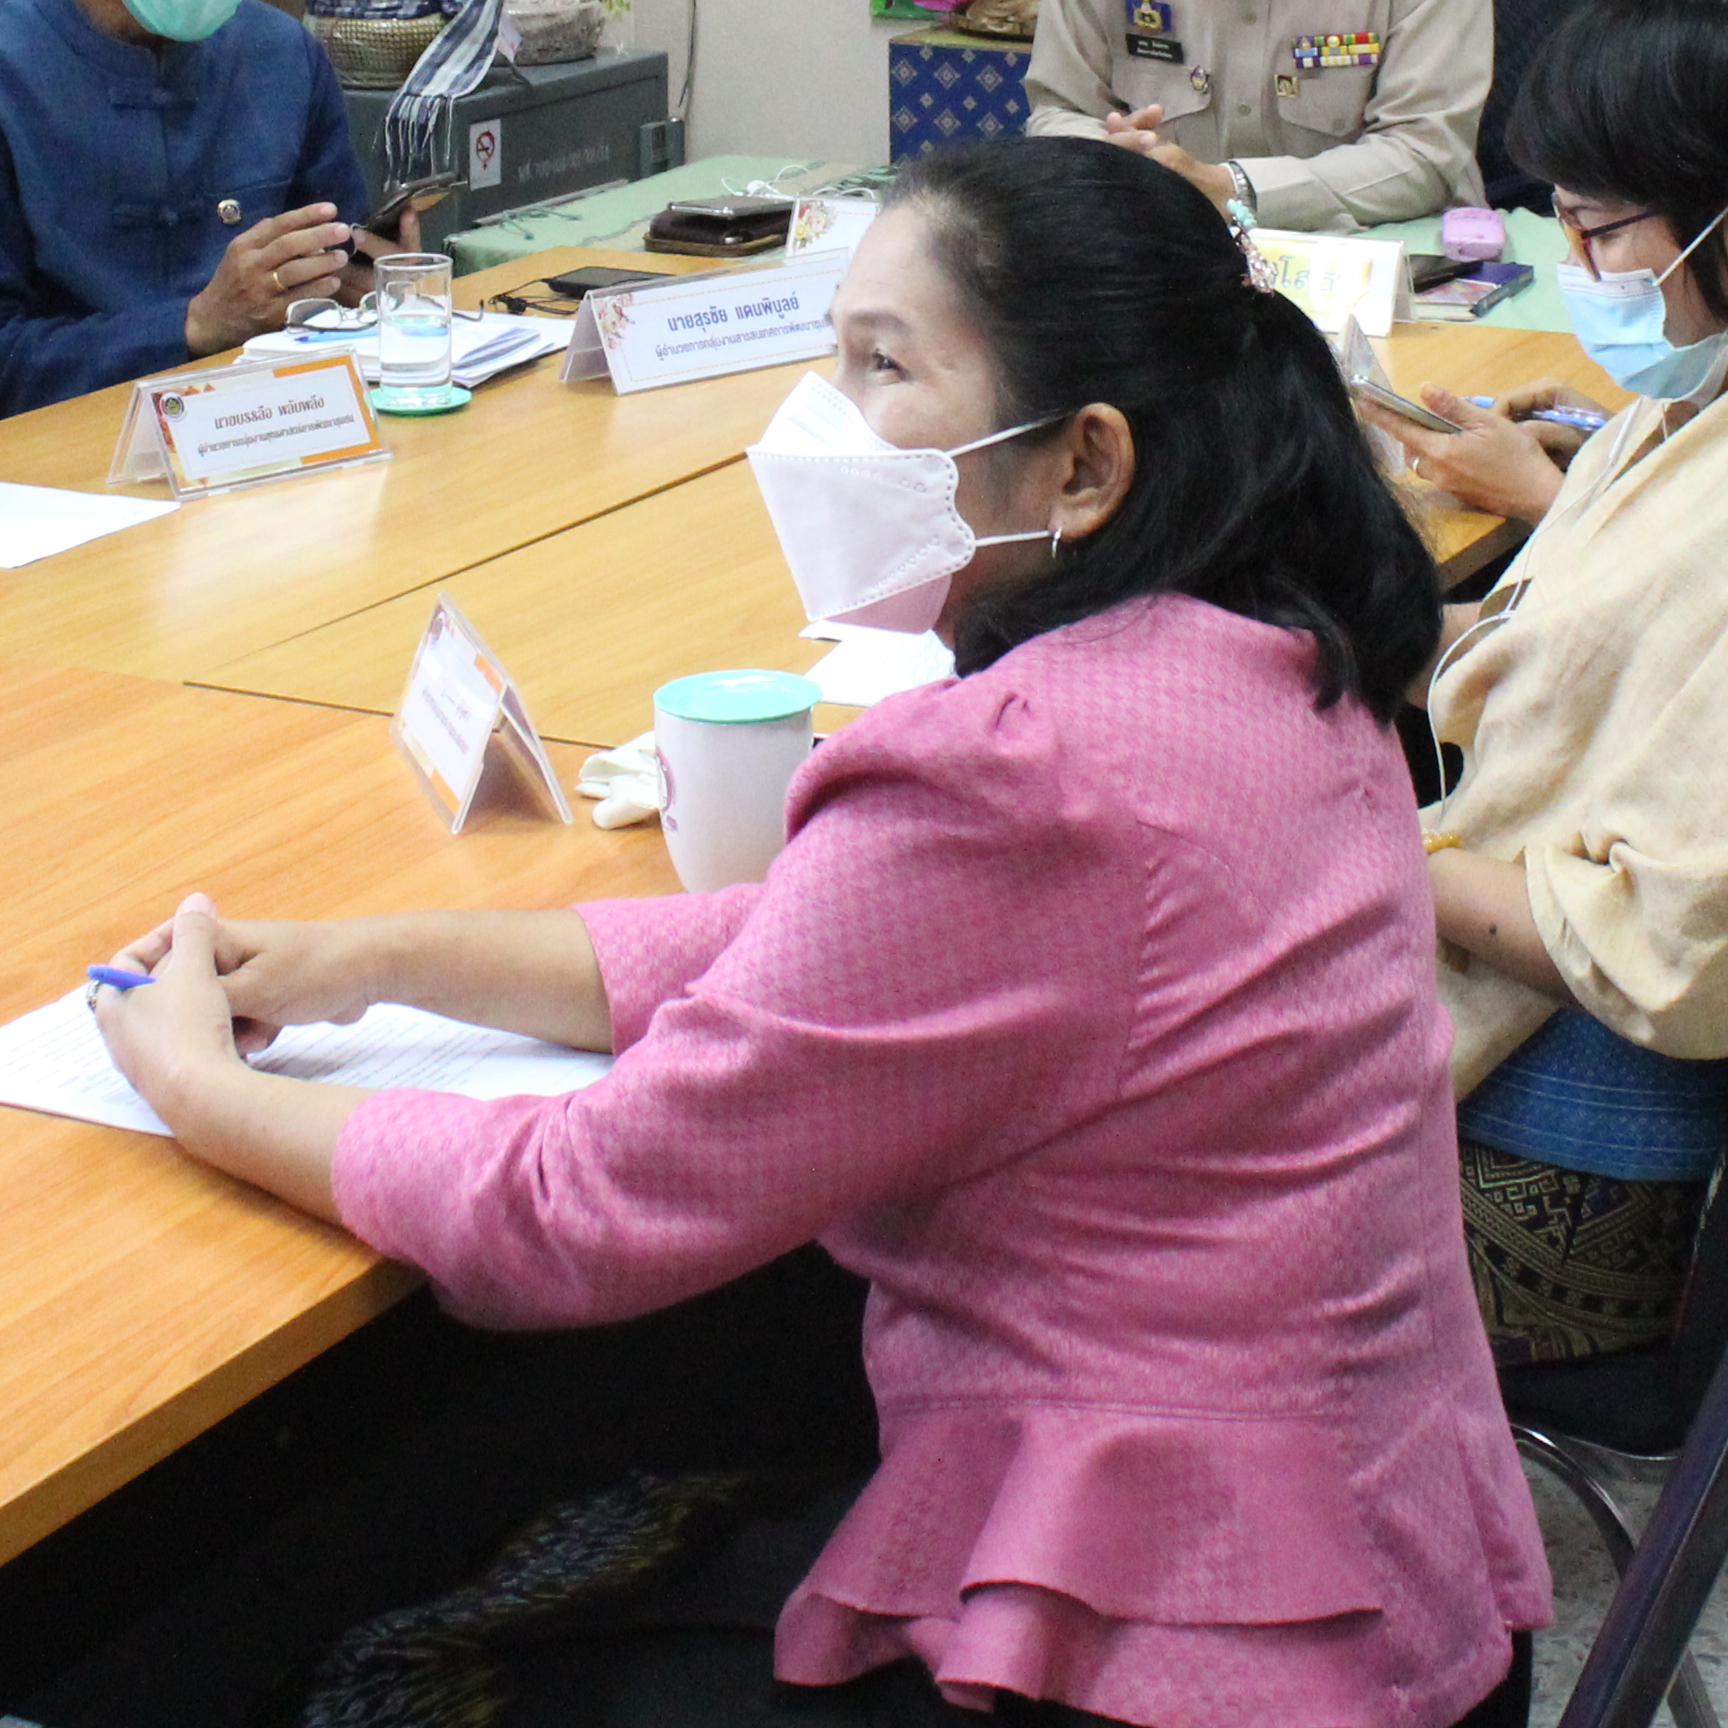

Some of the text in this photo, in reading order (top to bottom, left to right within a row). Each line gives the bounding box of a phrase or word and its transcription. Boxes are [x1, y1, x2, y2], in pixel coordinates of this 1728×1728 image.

[667, 291, 800, 333] นายสุรชัย แดนพิบูลย์
